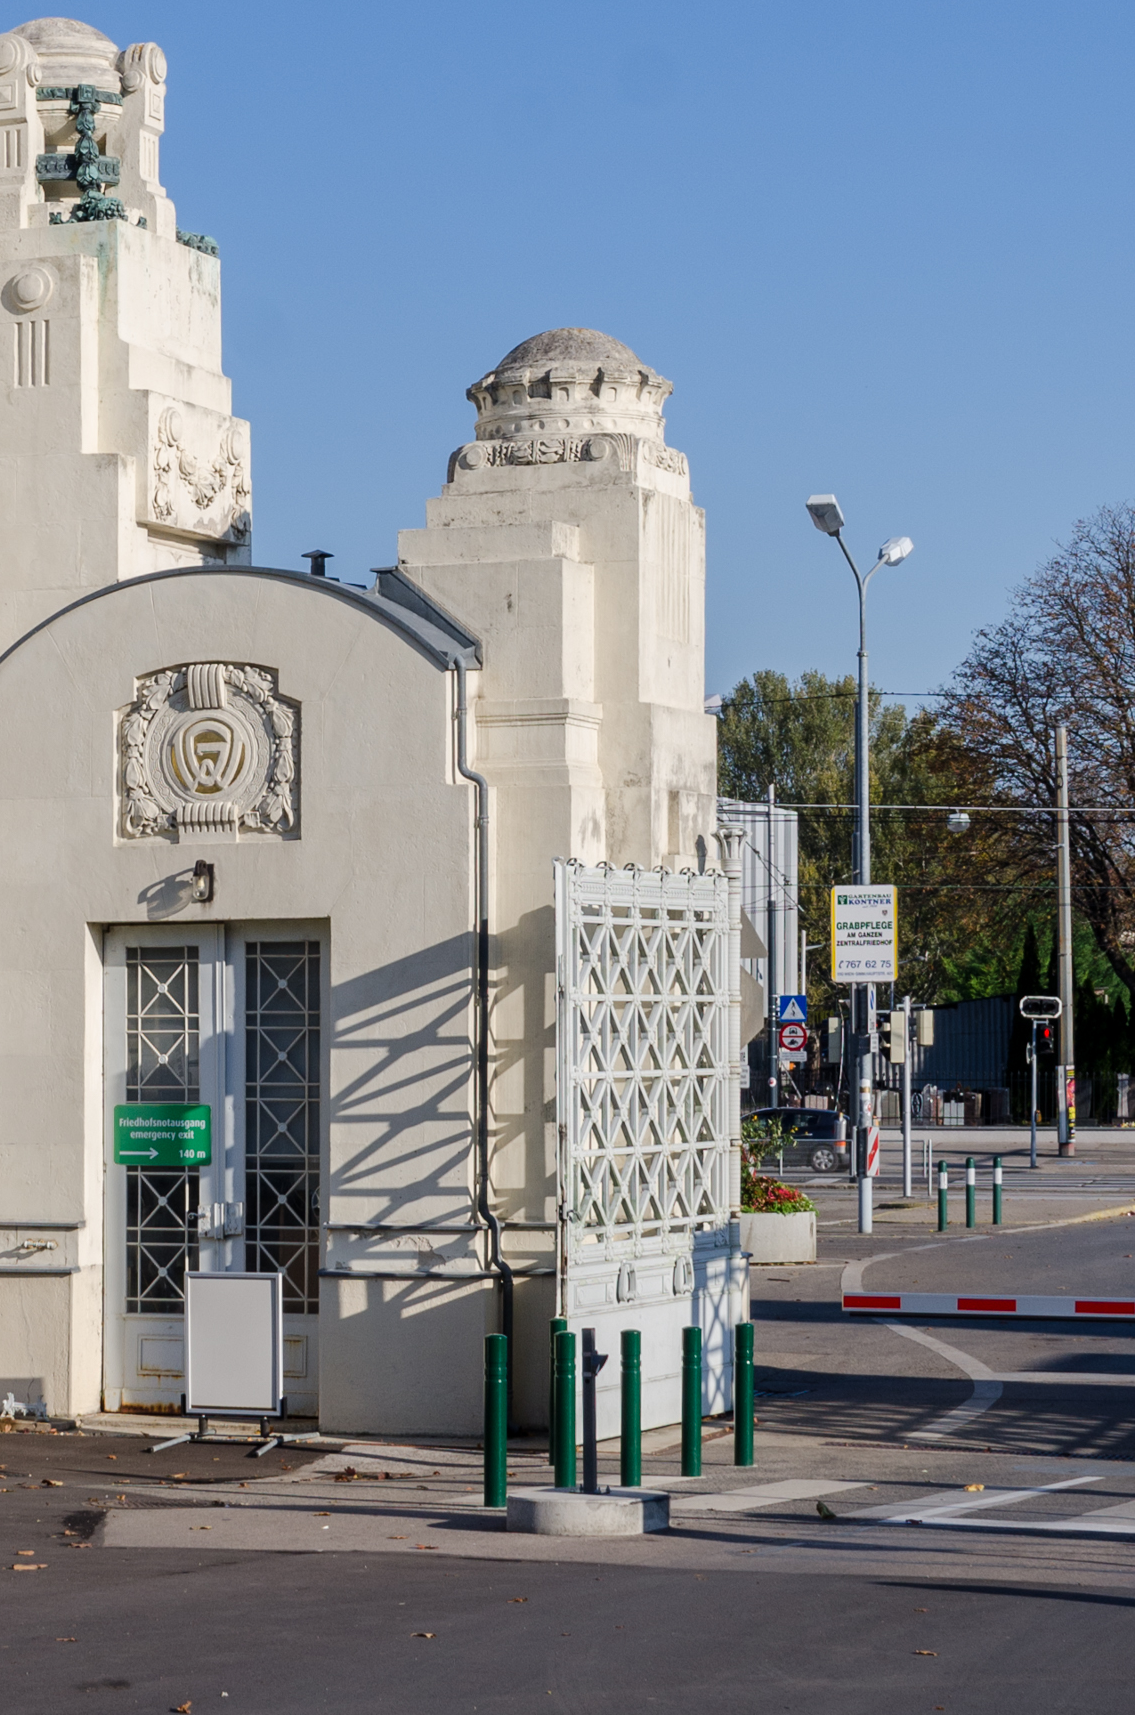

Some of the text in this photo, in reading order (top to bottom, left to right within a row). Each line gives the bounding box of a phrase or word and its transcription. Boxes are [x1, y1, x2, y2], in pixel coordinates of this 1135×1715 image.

[836, 921, 893, 930] GRABPFLEGE
[846, 960, 892, 968] 767 62 75
[119, 1117, 206, 1130] Friedhofsnotausgang
[130, 1129, 195, 1141] emergency exit
[179, 1149, 206, 1159] 140 m
